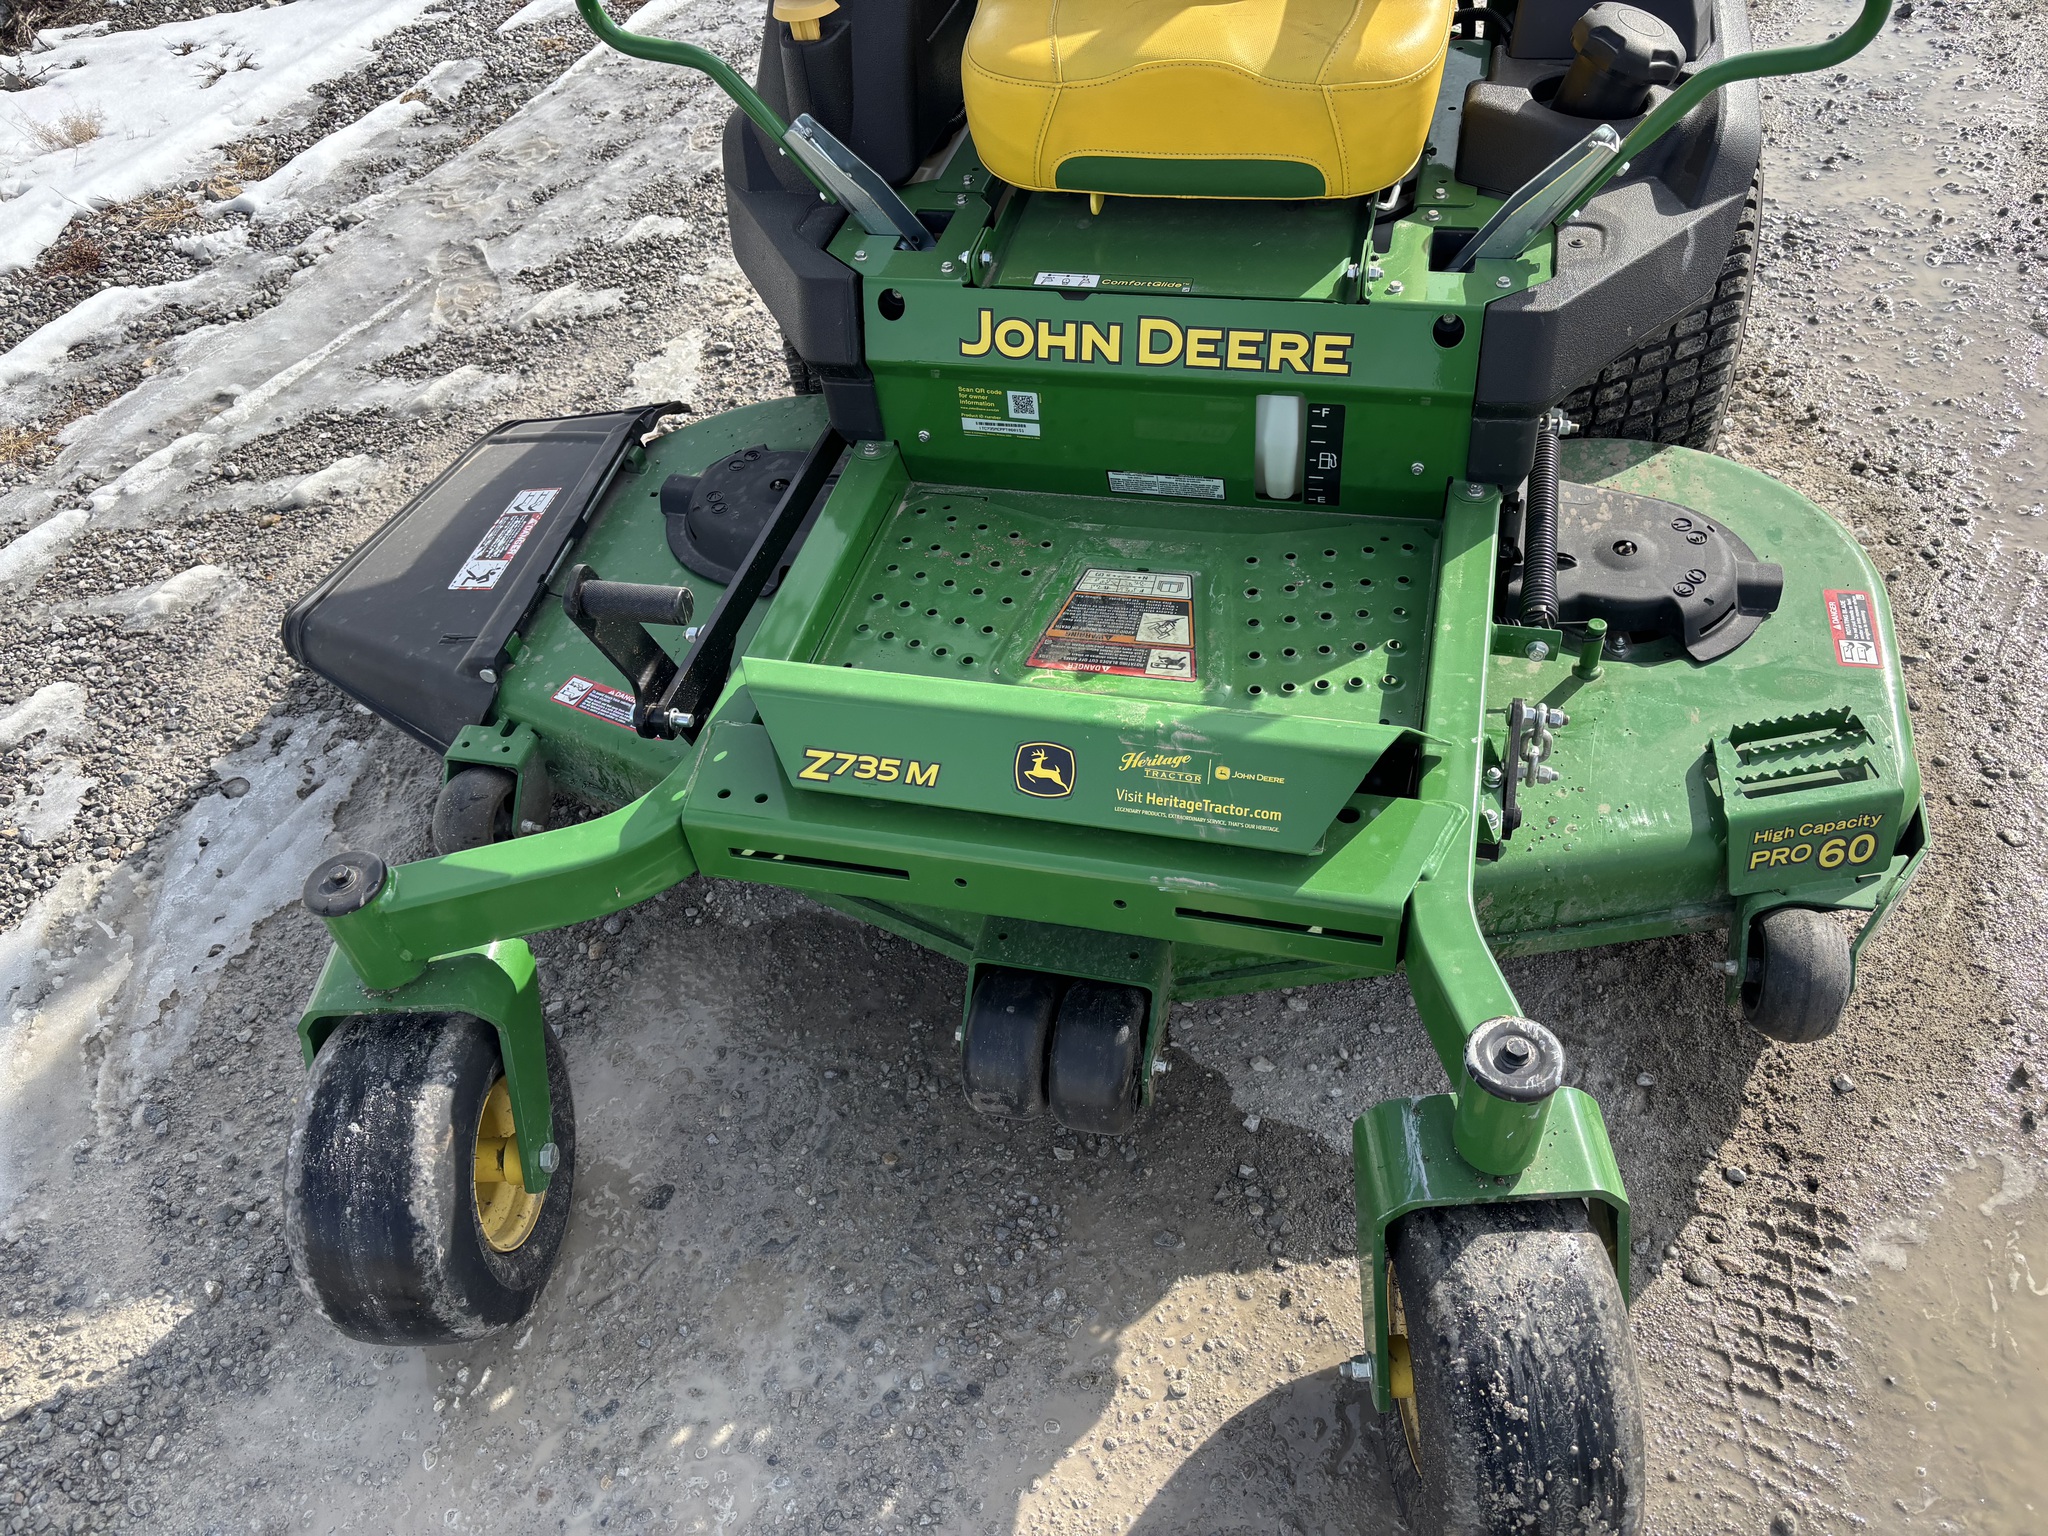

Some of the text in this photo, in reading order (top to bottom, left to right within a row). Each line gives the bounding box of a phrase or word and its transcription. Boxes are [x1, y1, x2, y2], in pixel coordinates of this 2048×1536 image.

[960, 308, 1354, 376] JOHN DEERE
[1321, 407, 1331, 418] F
[506, 525, 534, 554] DANGER
[1828, 601, 1839, 623] DANGER
[1063, 631, 1104, 639] WARNING
[1066, 662, 1101, 671] DANGER
[614, 690, 635, 703] DANG
[1118, 751, 1192, 771] Heritage
[1144, 768, 1202, 784] TRACTOR
[1231, 771, 1285, 784] JOHN DEERE
[1116, 788, 1282, 821] Visit HeritageTractor.com
[1114, 806, 1141, 815] LEGENDARY
[1141, 810, 1168, 819] PRODUCTS,
[1168, 813, 1206, 823] EXTRAORDINARY
[1206, 818, 1227, 826] SERVICE,
[1753, 814, 1883, 844] High Capacity
[1749, 833, 1876, 870] PRO 60
